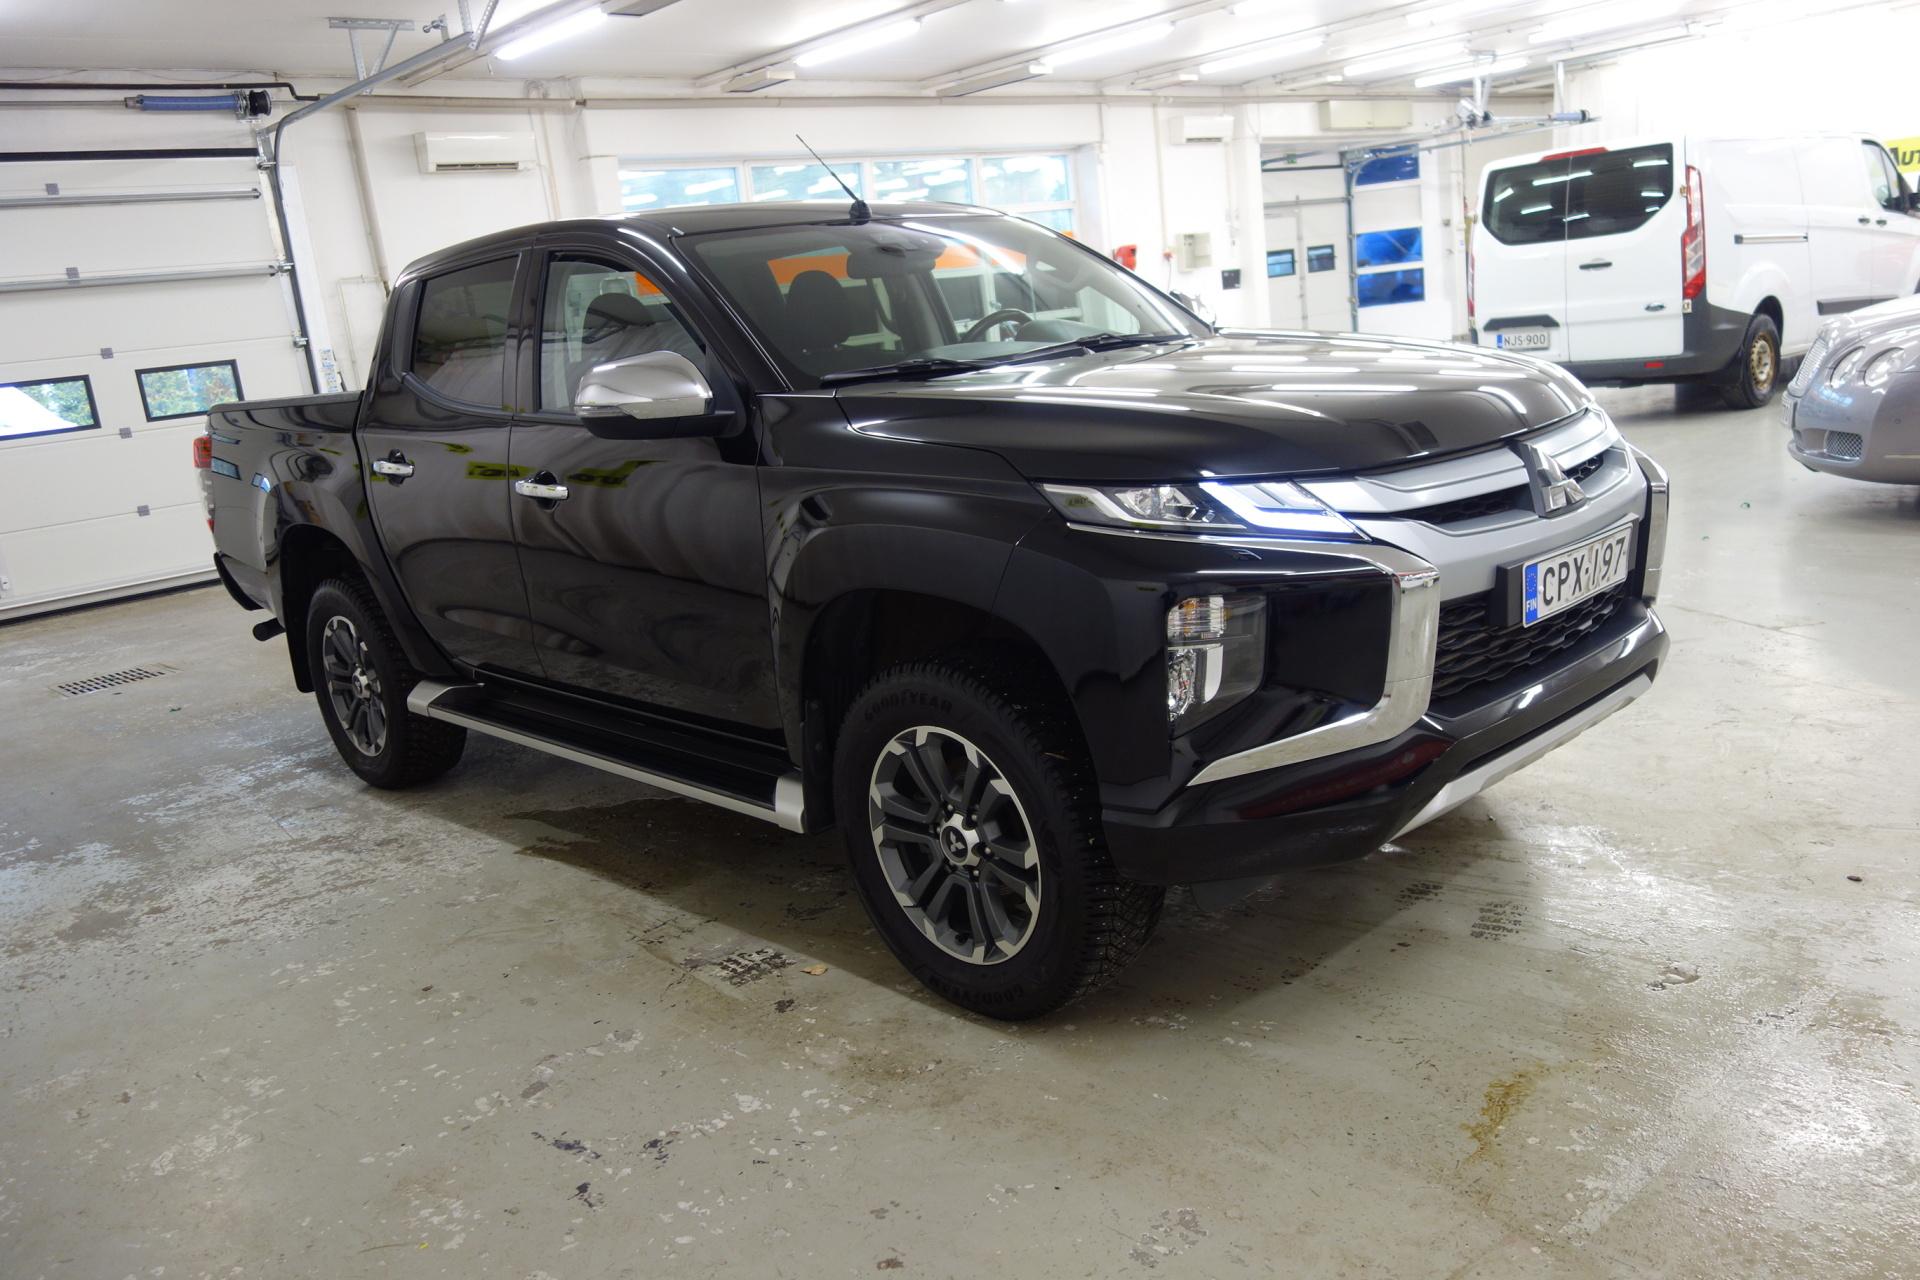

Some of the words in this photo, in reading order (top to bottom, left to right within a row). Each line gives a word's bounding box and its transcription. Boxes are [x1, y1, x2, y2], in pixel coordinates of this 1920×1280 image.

[1504, 334, 1546, 346] NJS-900
[1543, 536, 1626, 606] CPX-197
[1526, 598, 1537, 613] FIN
[865, 691, 952, 719] GOODYEAR
